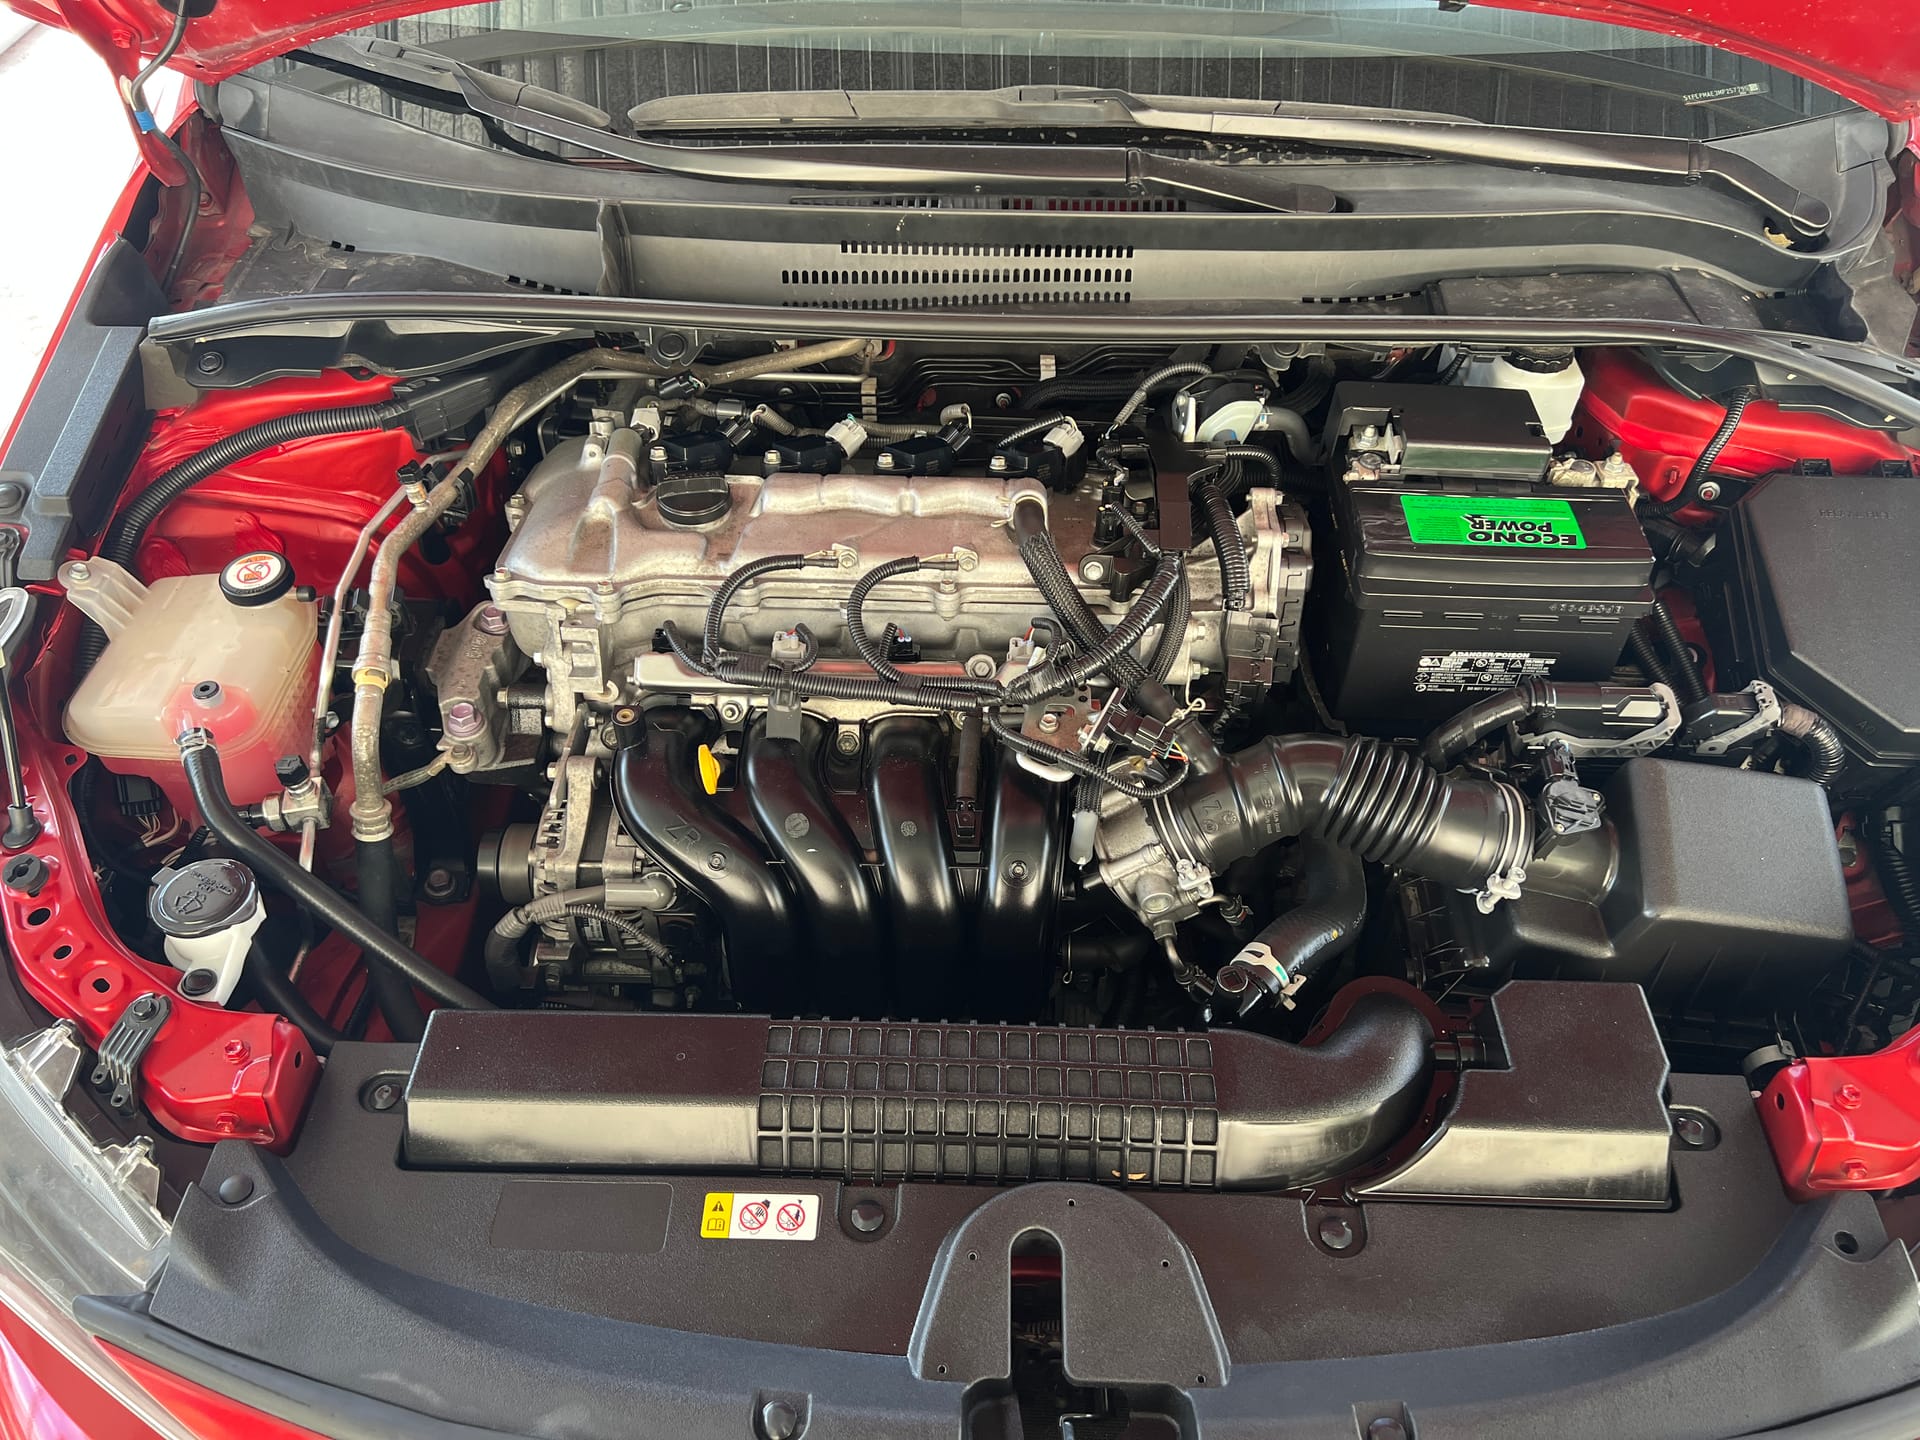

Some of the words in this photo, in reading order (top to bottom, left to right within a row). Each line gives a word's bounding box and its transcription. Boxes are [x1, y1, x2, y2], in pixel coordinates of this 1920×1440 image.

[1466, 517, 1553, 532] POWER
[1466, 530, 1578, 547] ECONO
[1456, 651, 1531, 659] DANGER/POISON
